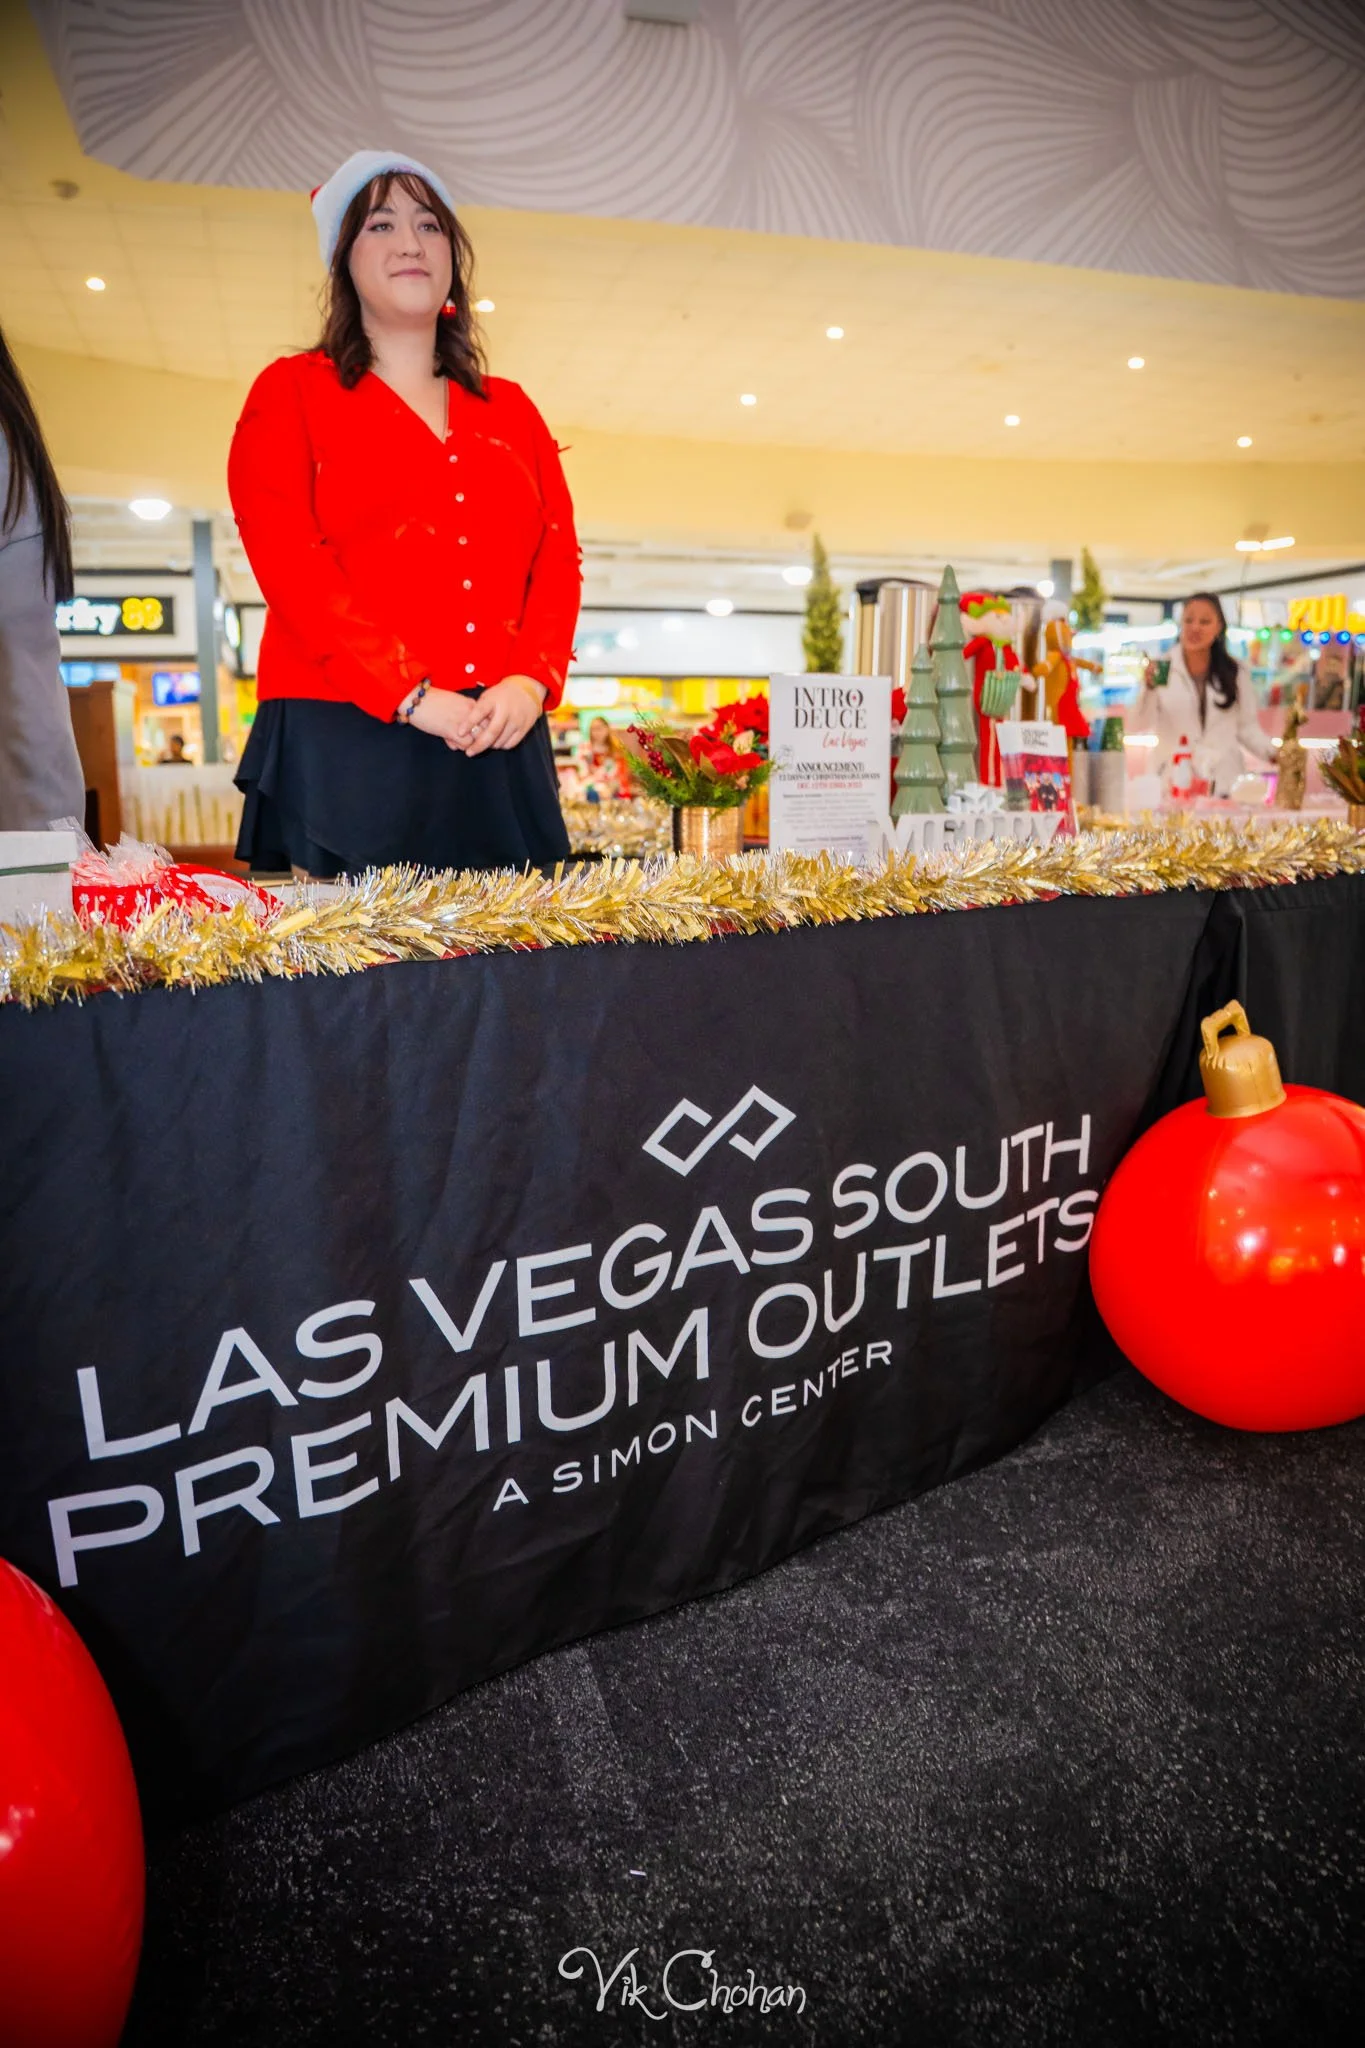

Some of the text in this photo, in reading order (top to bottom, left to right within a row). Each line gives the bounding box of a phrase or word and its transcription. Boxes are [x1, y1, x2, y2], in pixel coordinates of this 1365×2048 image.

[794, 686, 864, 707] INTRO
[794, 708, 867, 729] DEUCE
[76, 1114, 1091, 1460] LAS VEGAS SOUTH
[47, 1190, 1099, 1588] PREMIUM OUTLETS
[493, 1340, 893, 1512] A SIMON CENTER
